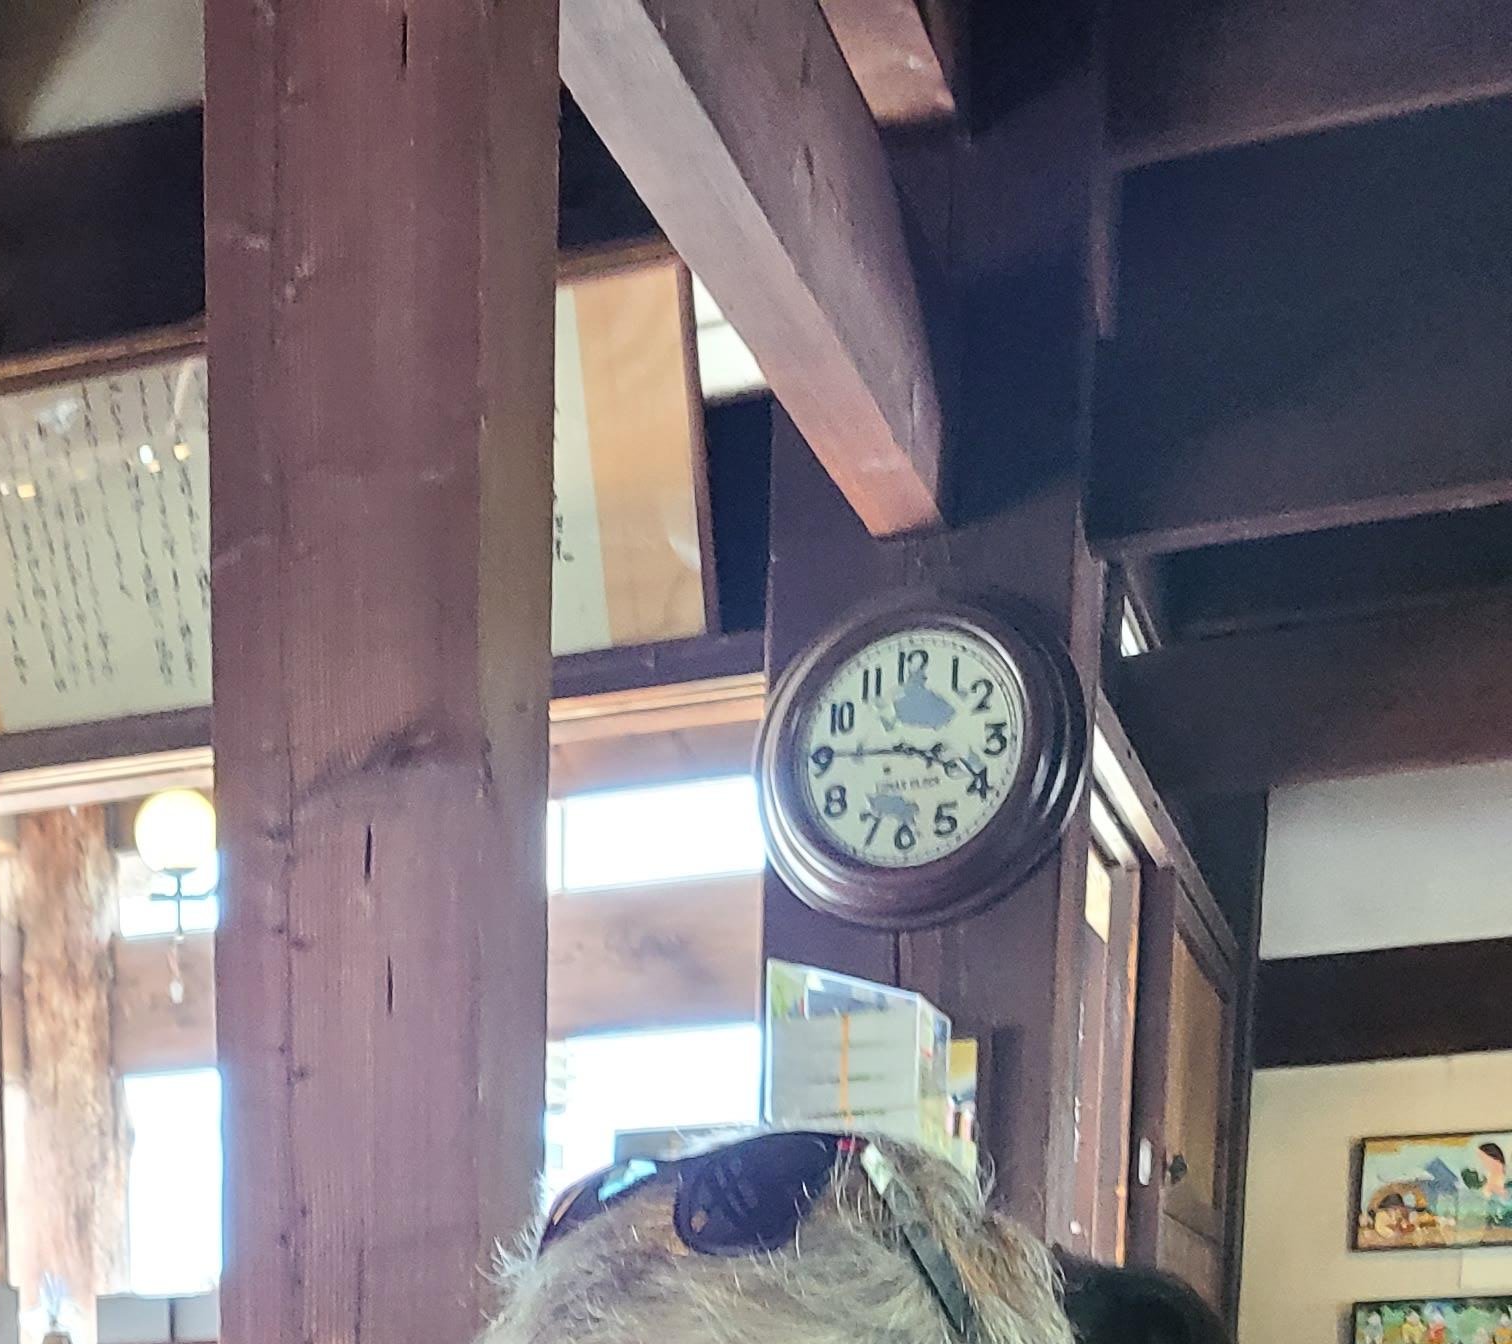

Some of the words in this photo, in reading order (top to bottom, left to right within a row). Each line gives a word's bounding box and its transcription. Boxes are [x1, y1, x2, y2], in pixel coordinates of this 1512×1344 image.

[862, 667, 882, 700] 11
[898, 650, 929, 685] 12
[970, 679, 994, 713] 2
[830, 701, 855, 734] 10
[984, 723, 1008, 756] 3
[810, 746, 835, 777] 9
[823, 785, 848, 817] 8
[860, 812, 882, 846] 7
[894, 817, 917, 850] 6
[934, 802, 959, 837] 5
